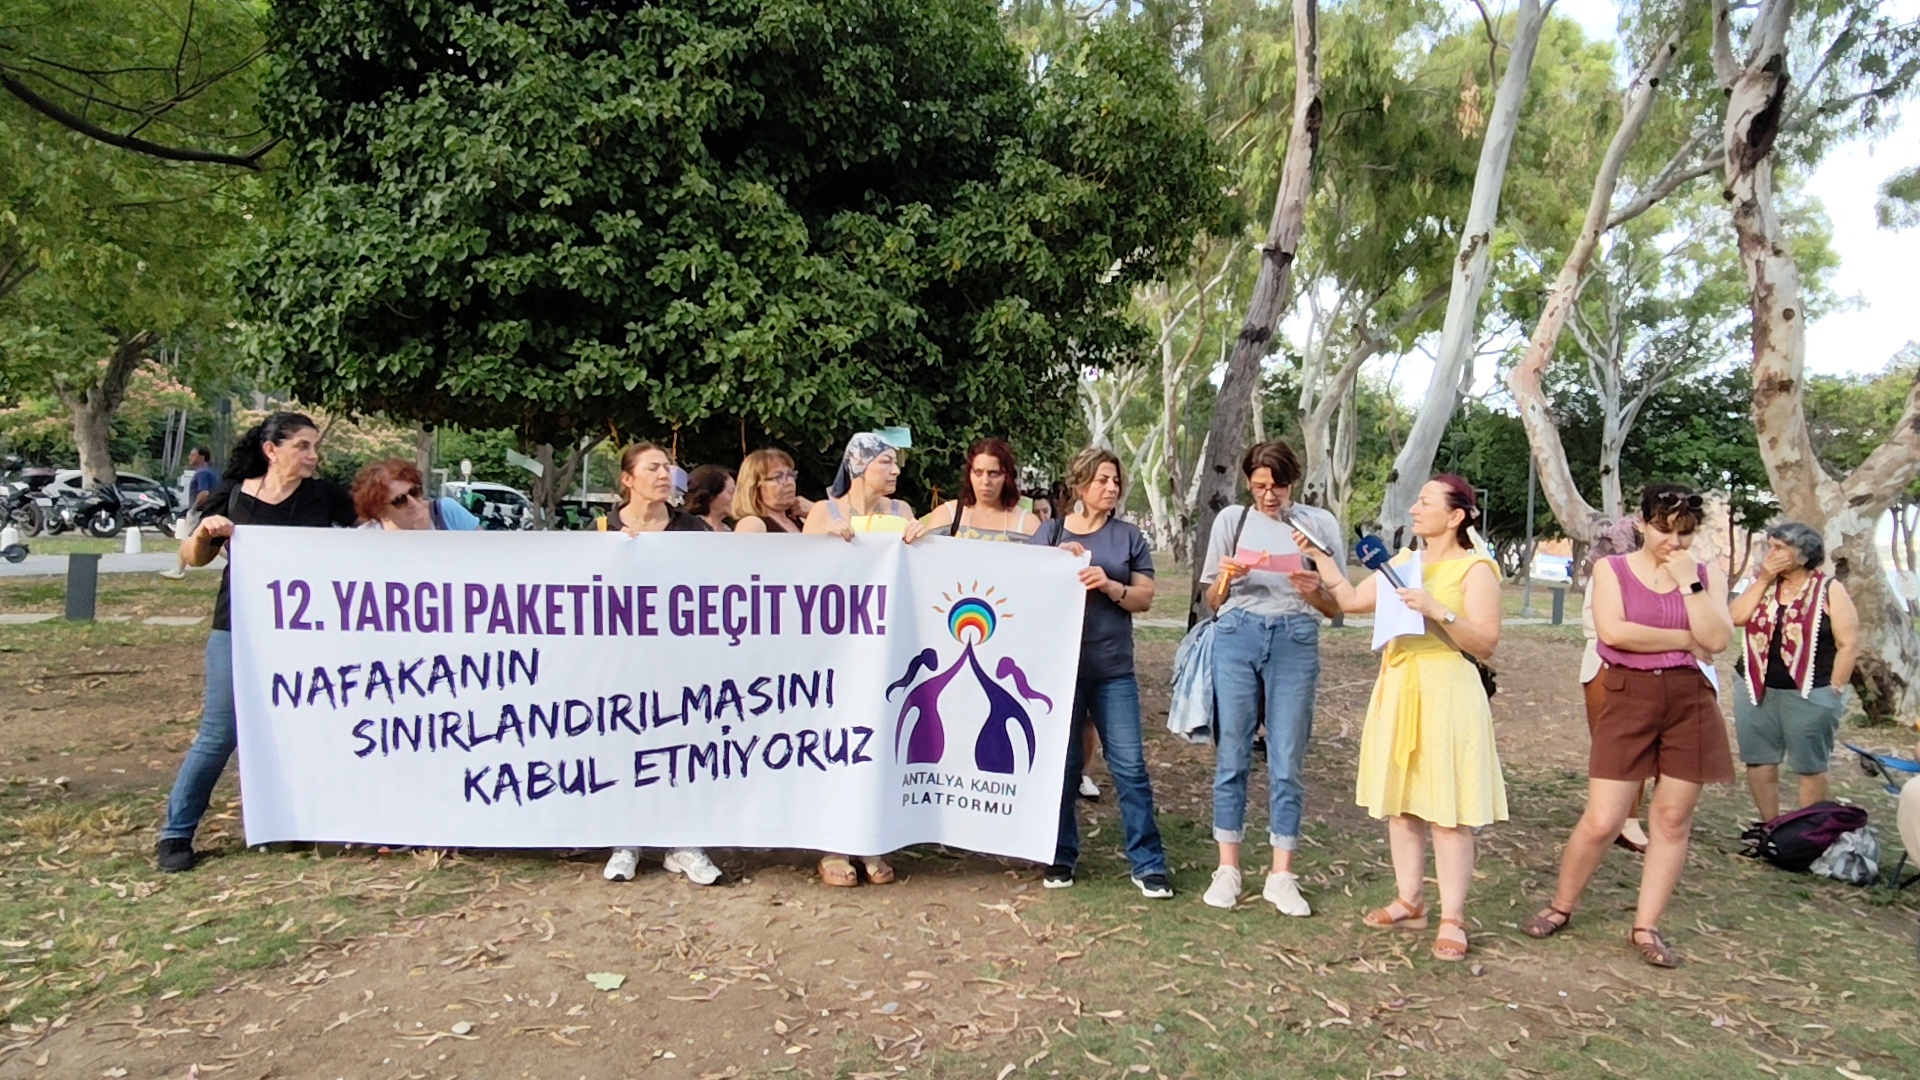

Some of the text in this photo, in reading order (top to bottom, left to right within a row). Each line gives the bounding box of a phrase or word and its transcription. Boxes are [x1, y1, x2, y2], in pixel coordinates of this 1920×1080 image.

[266, 574, 887, 647] 12. YARGI PAKETİNE GEÇİT YOK!
[272, 648, 540, 711] NAFAKANIN
[351, 668, 835, 759] SINIRLANDIRILMASINI
[463, 725, 875, 807] KABUL ETMİYORUZ
[902, 771, 1017, 797] ANTALYA KADIN
[902, 791, 1013, 816] PLATFORMU
